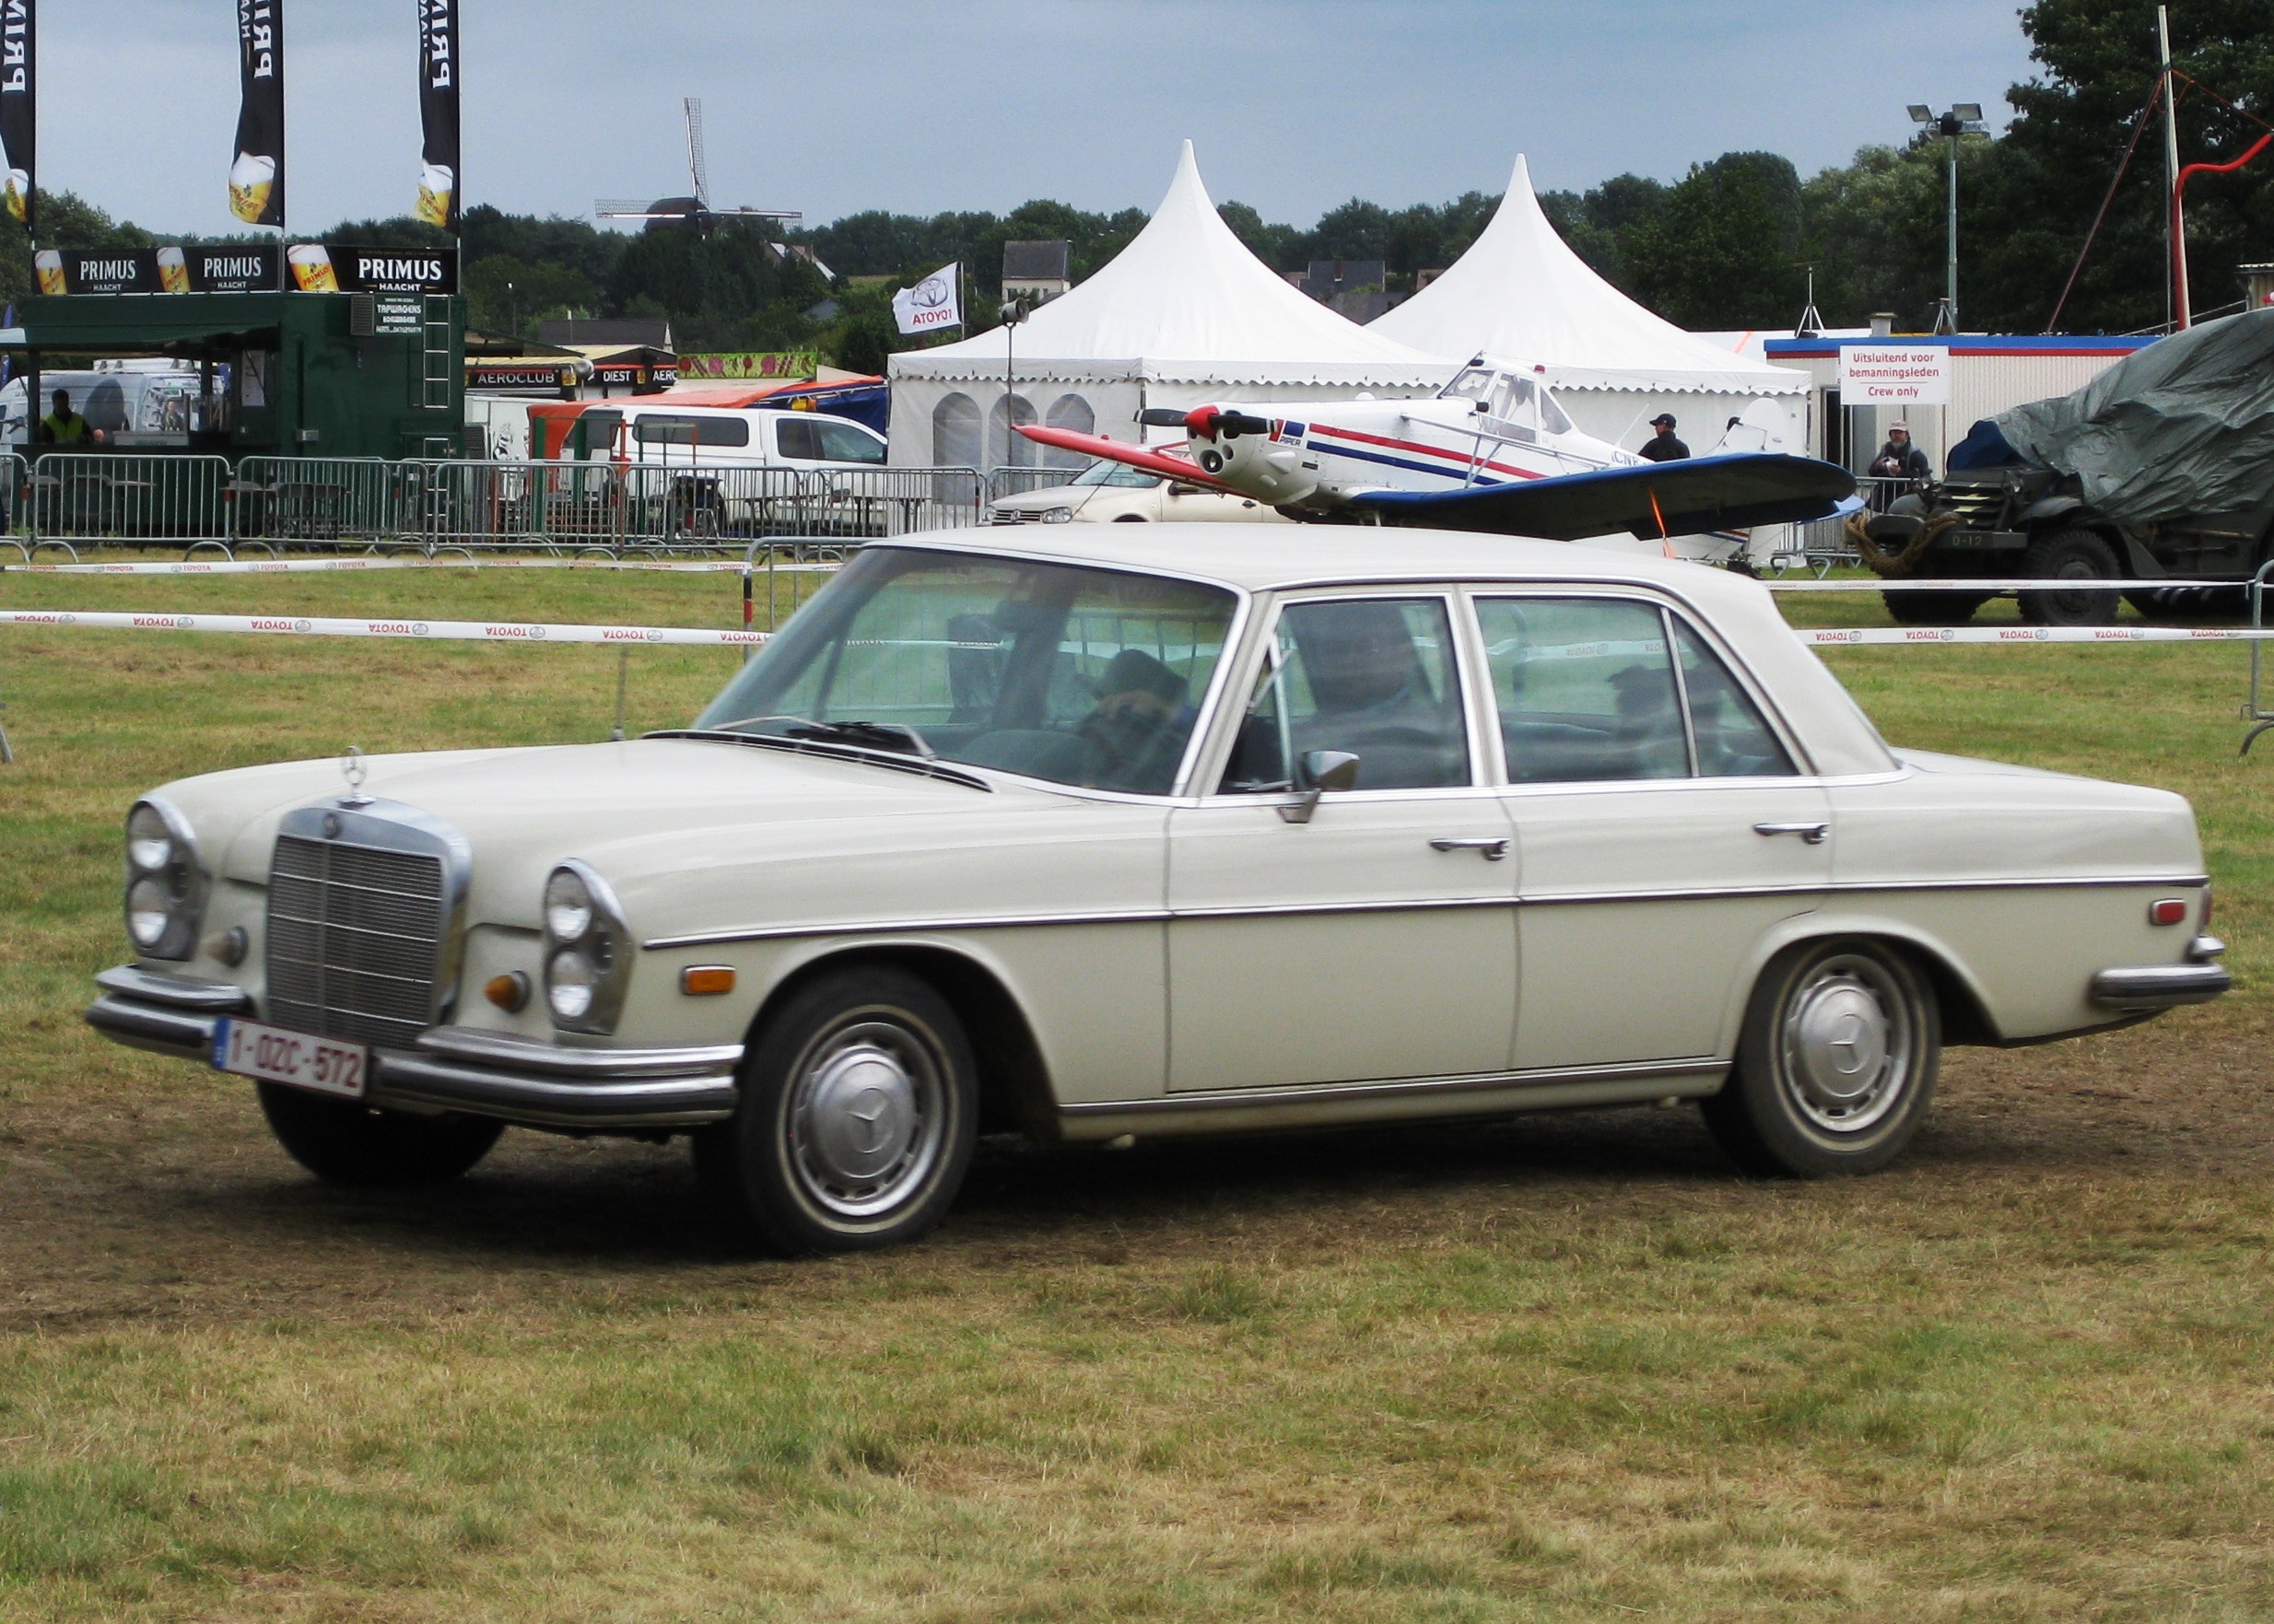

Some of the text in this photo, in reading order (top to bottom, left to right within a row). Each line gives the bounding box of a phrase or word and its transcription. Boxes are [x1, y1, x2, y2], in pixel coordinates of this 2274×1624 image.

[80, 260, 136, 280] PRIMUS
[204, 256, 262, 278] PRIMUS
[358, 258, 442, 280] PRIMUS
[93, 283, 122, 291] HAACHT
[217, 280, 247, 289] HAACHT
[379, 282, 421, 292] HAACHT
[1853, 352, 1935, 363] Uitsluitend voor
[477, 371, 555, 384] AEROCLUB
[603, 370, 631, 382] DIEST
[1849, 367, 1940, 380] bemanningsleden
[1868, 386, 1919, 398] Crew only
[183, 564, 212, 572] TOYOTA
[134, 616, 175, 627] TOYOTA
[251, 620, 294, 631] TOYOTA
[369, 623, 410, 634] TOYOTA
[485, 626, 527, 637] TOYOTA
[602, 630, 645, 640] TOYOTA
[720, 633, 762, 643] TOYOTA
[1815, 632, 1848, 641] TOYOTA
[1905, 631, 1940, 640] TOYOTA
[1999, 630, 2034, 639] TOYOTA
[2094, 629, 2129, 638] TOYOTA
[232, 1024, 362, 1088] 1-OZC-572
